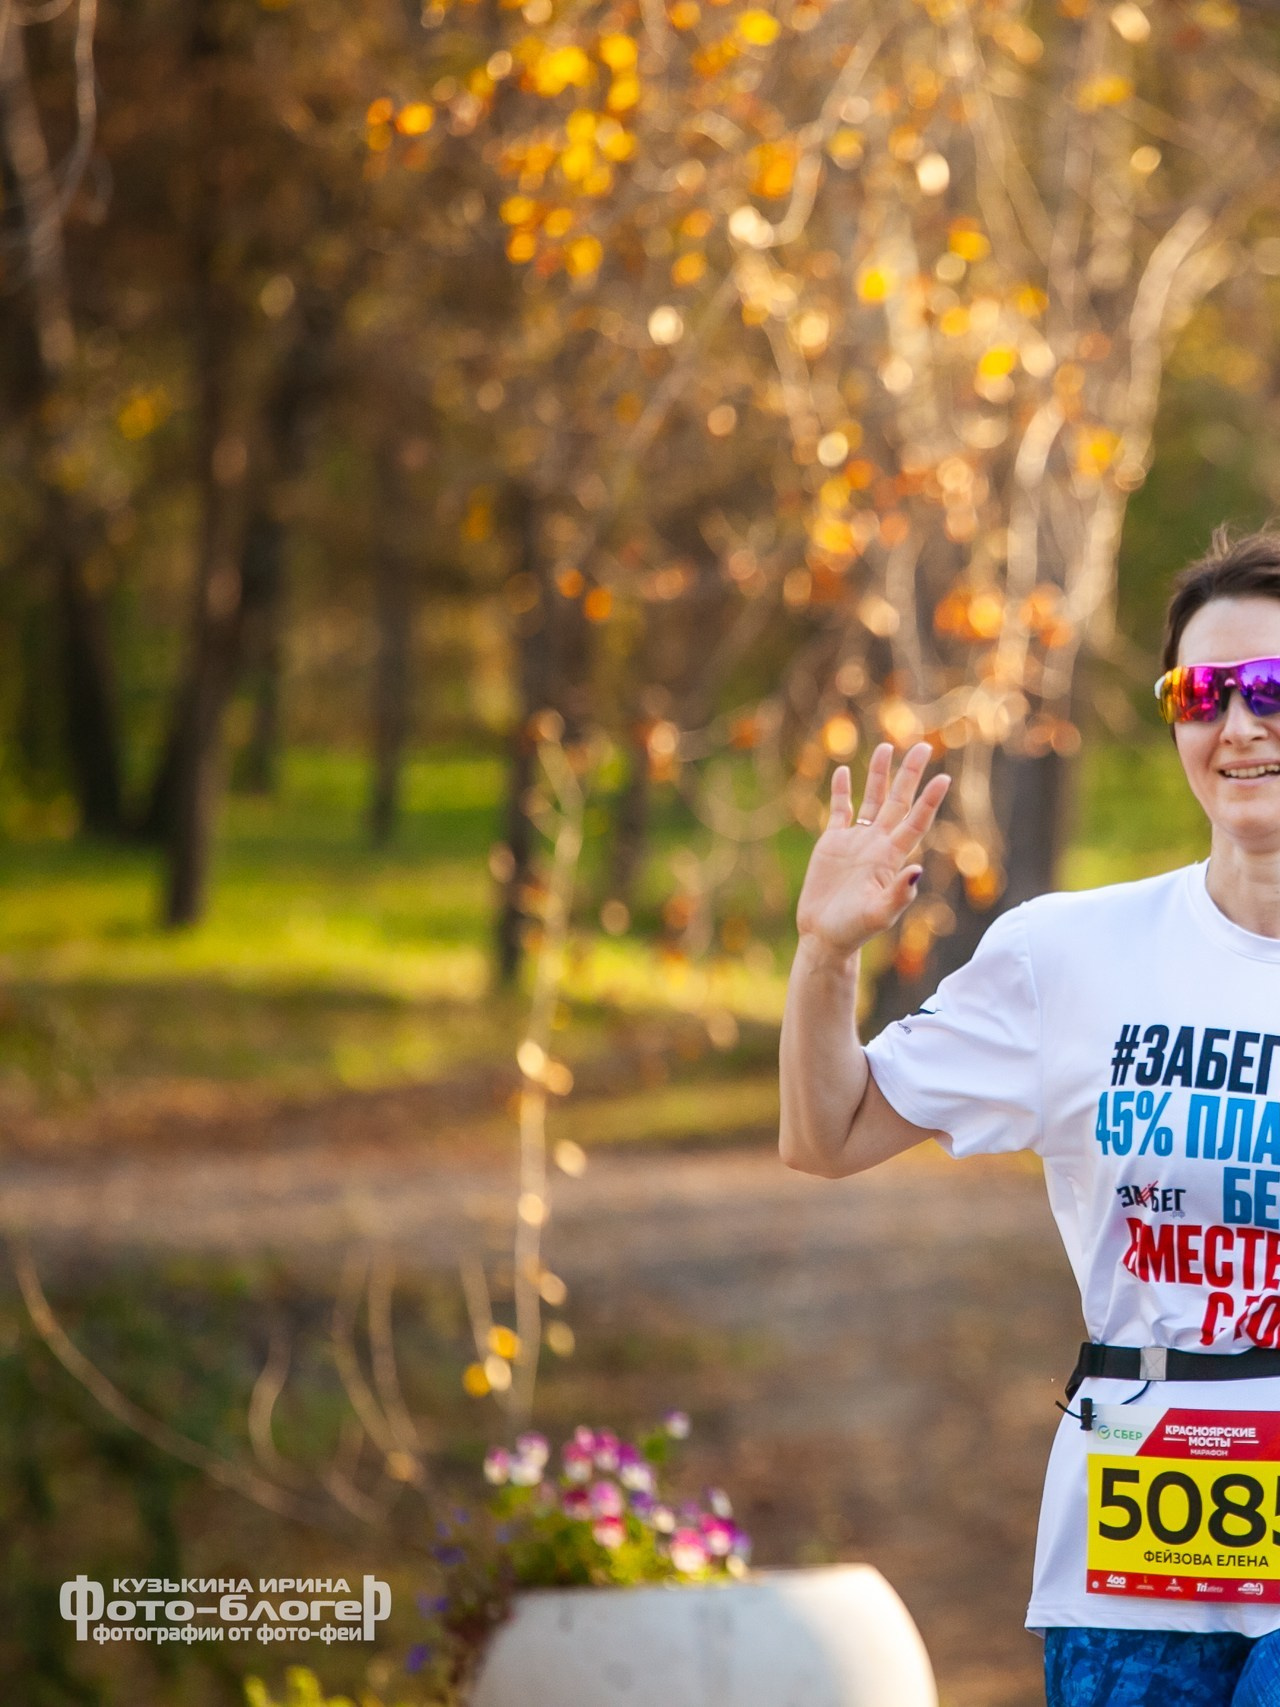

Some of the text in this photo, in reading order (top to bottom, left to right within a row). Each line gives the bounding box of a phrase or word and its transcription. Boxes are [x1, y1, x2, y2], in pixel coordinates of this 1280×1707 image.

[1095, 1090, 1172, 1157] 45%
[1116, 1180, 1186, 1213] ЗАБЕГ
[1113, 1430, 1143, 1441] СБЕР
[1165, 1425, 1256, 1438] КРАСНОЯРСКИЕ
[1188, 1437, 1231, 1448] МОСТЫ
[1190, 1449, 1229, 1457] МАРАФОН
[1143, 1550, 1269, 1567] ФЕЙЗОВА ЕЛЕНА
